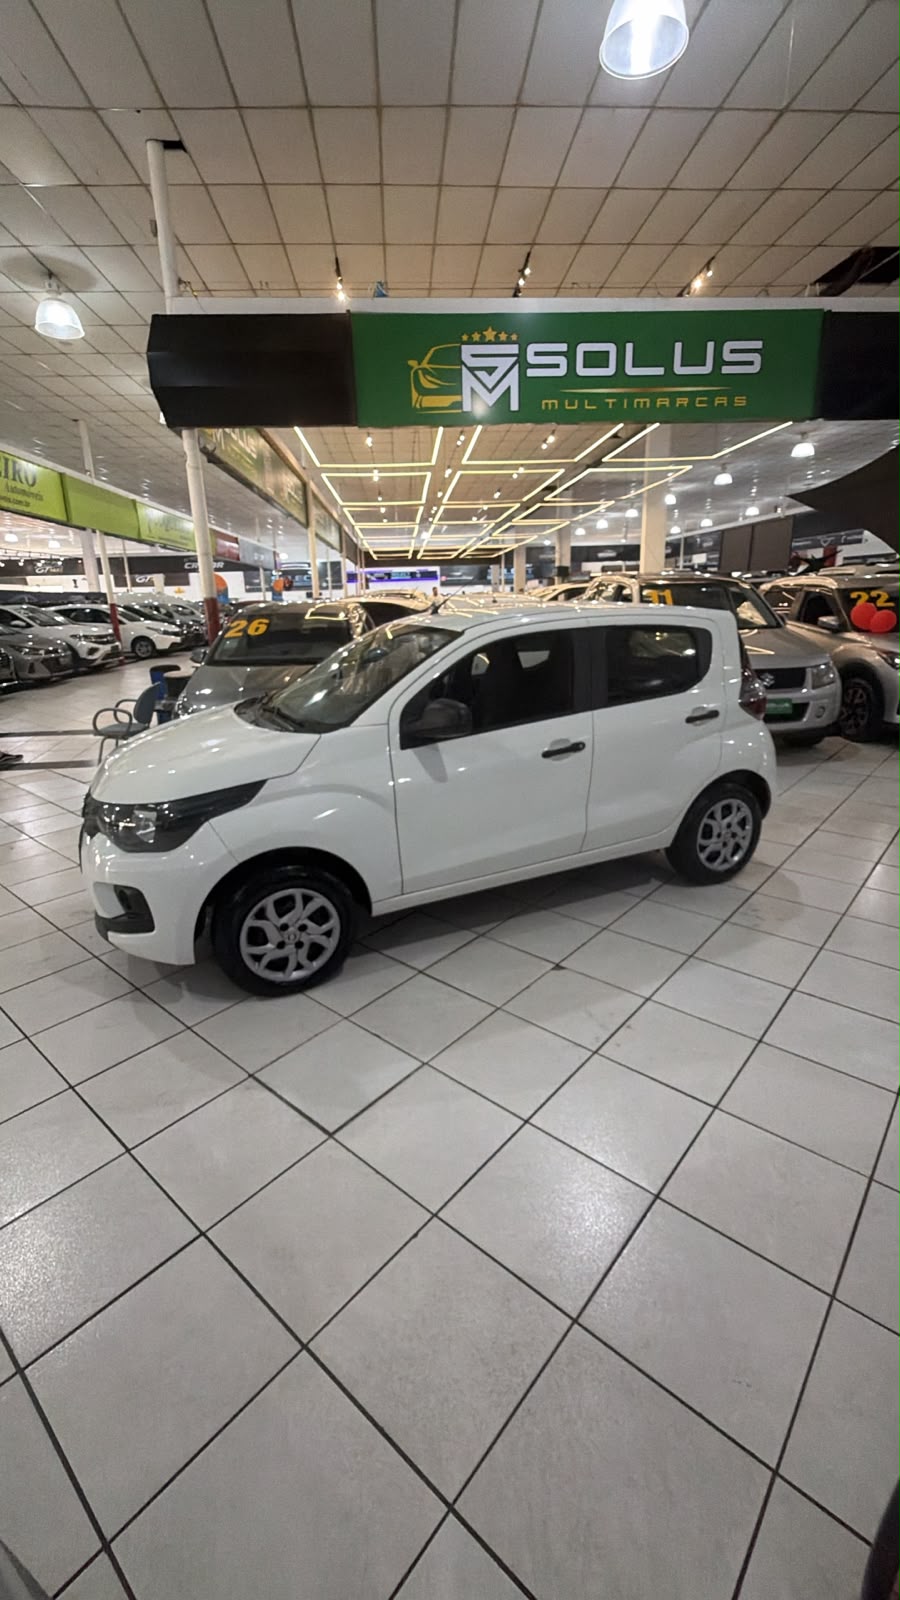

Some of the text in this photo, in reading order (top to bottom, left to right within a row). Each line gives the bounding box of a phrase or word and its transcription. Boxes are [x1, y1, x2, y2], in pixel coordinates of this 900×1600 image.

[526, 340, 763, 377] SOLUS
[541, 396, 748, 411] MULTIMARCAS
[0, 456, 37, 487] IRO
[850, 590, 895, 608] 22
[224, 619, 269, 638] 26
